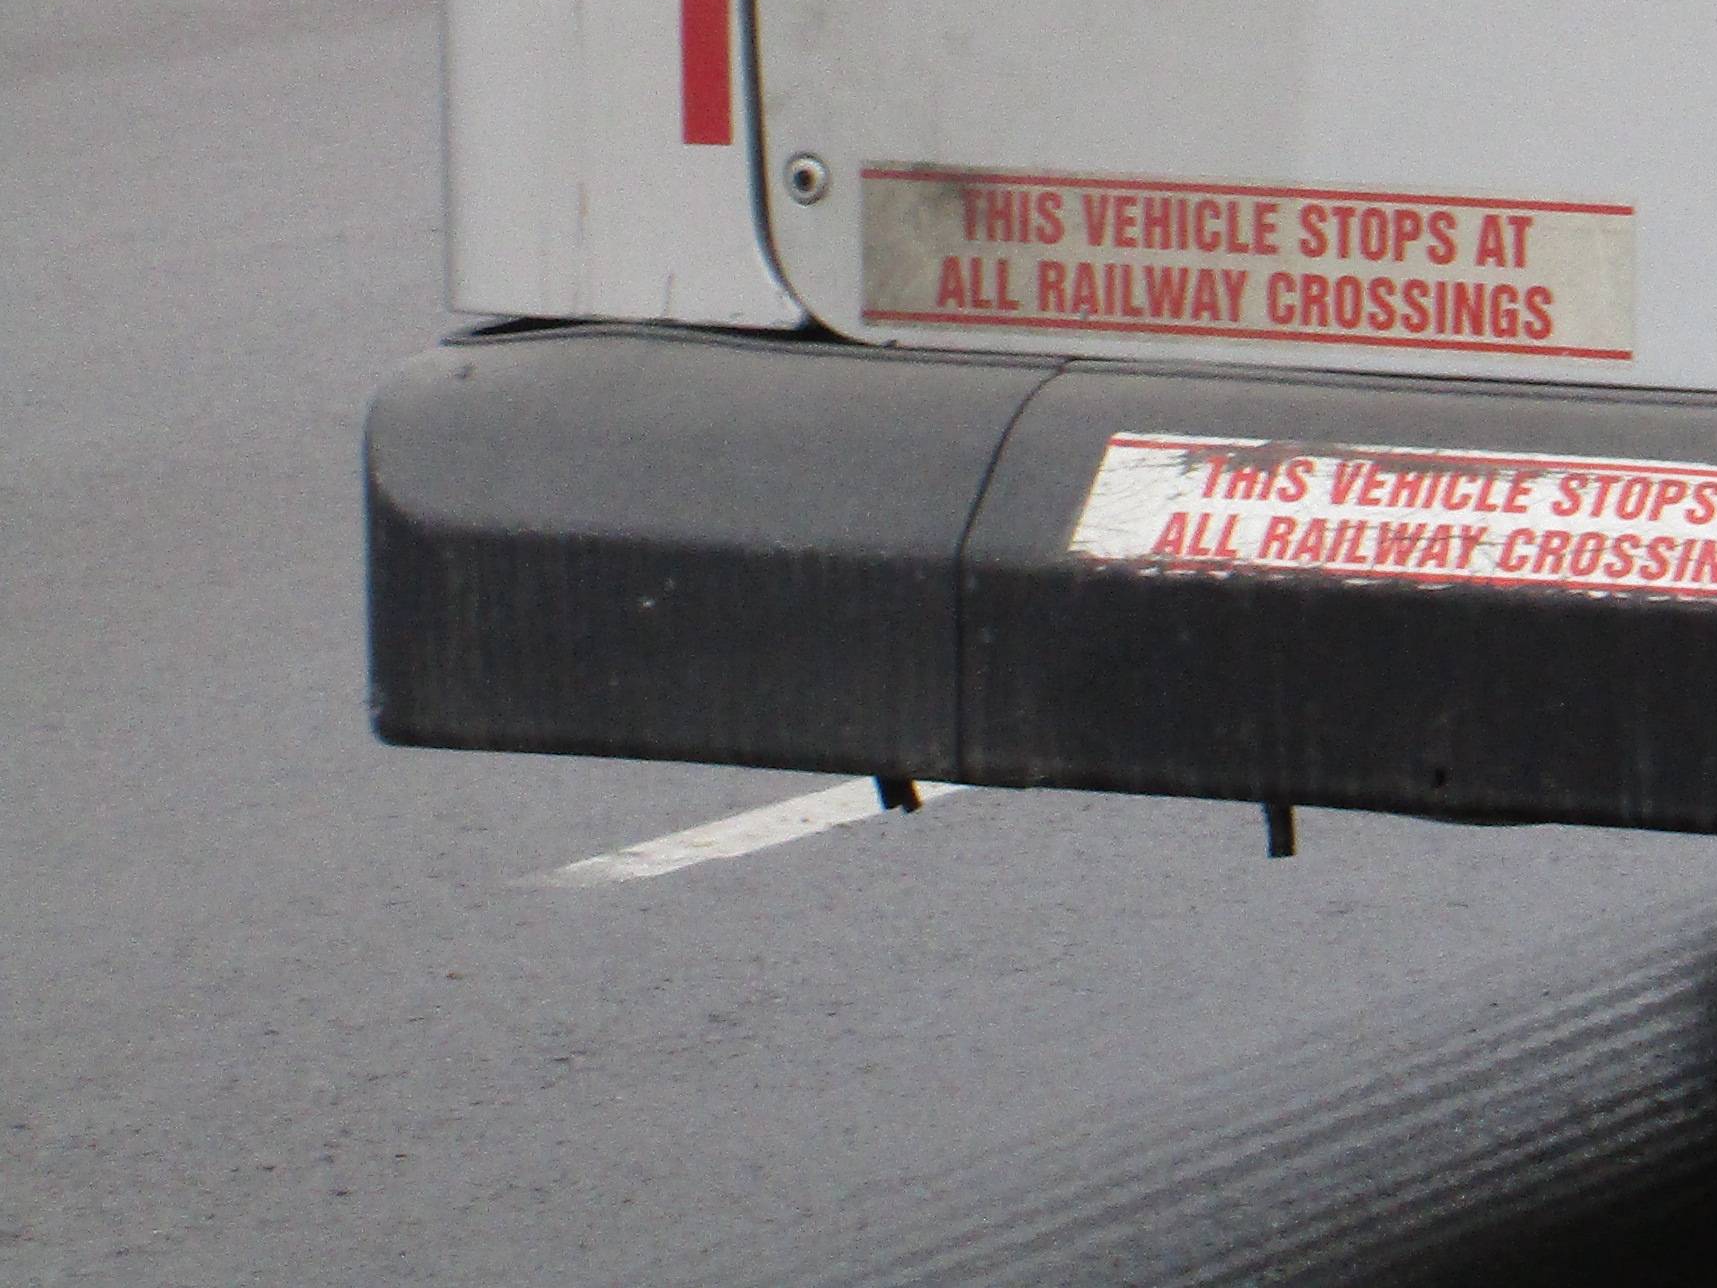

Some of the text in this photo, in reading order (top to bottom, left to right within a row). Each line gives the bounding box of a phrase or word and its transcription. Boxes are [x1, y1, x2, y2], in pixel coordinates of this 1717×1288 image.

[962, 188, 1535, 268] THIS VEHICLE STOPS AT
[935, 255, 1555, 340] ALL RAILWAY CROSSINGS
[1203, 454, 1316, 503] THIS
[1329, 460, 1541, 514] VEHICLE
[1152, 511, 1239, 558] ALL
[1258, 515, 1488, 569] RAILWAY
